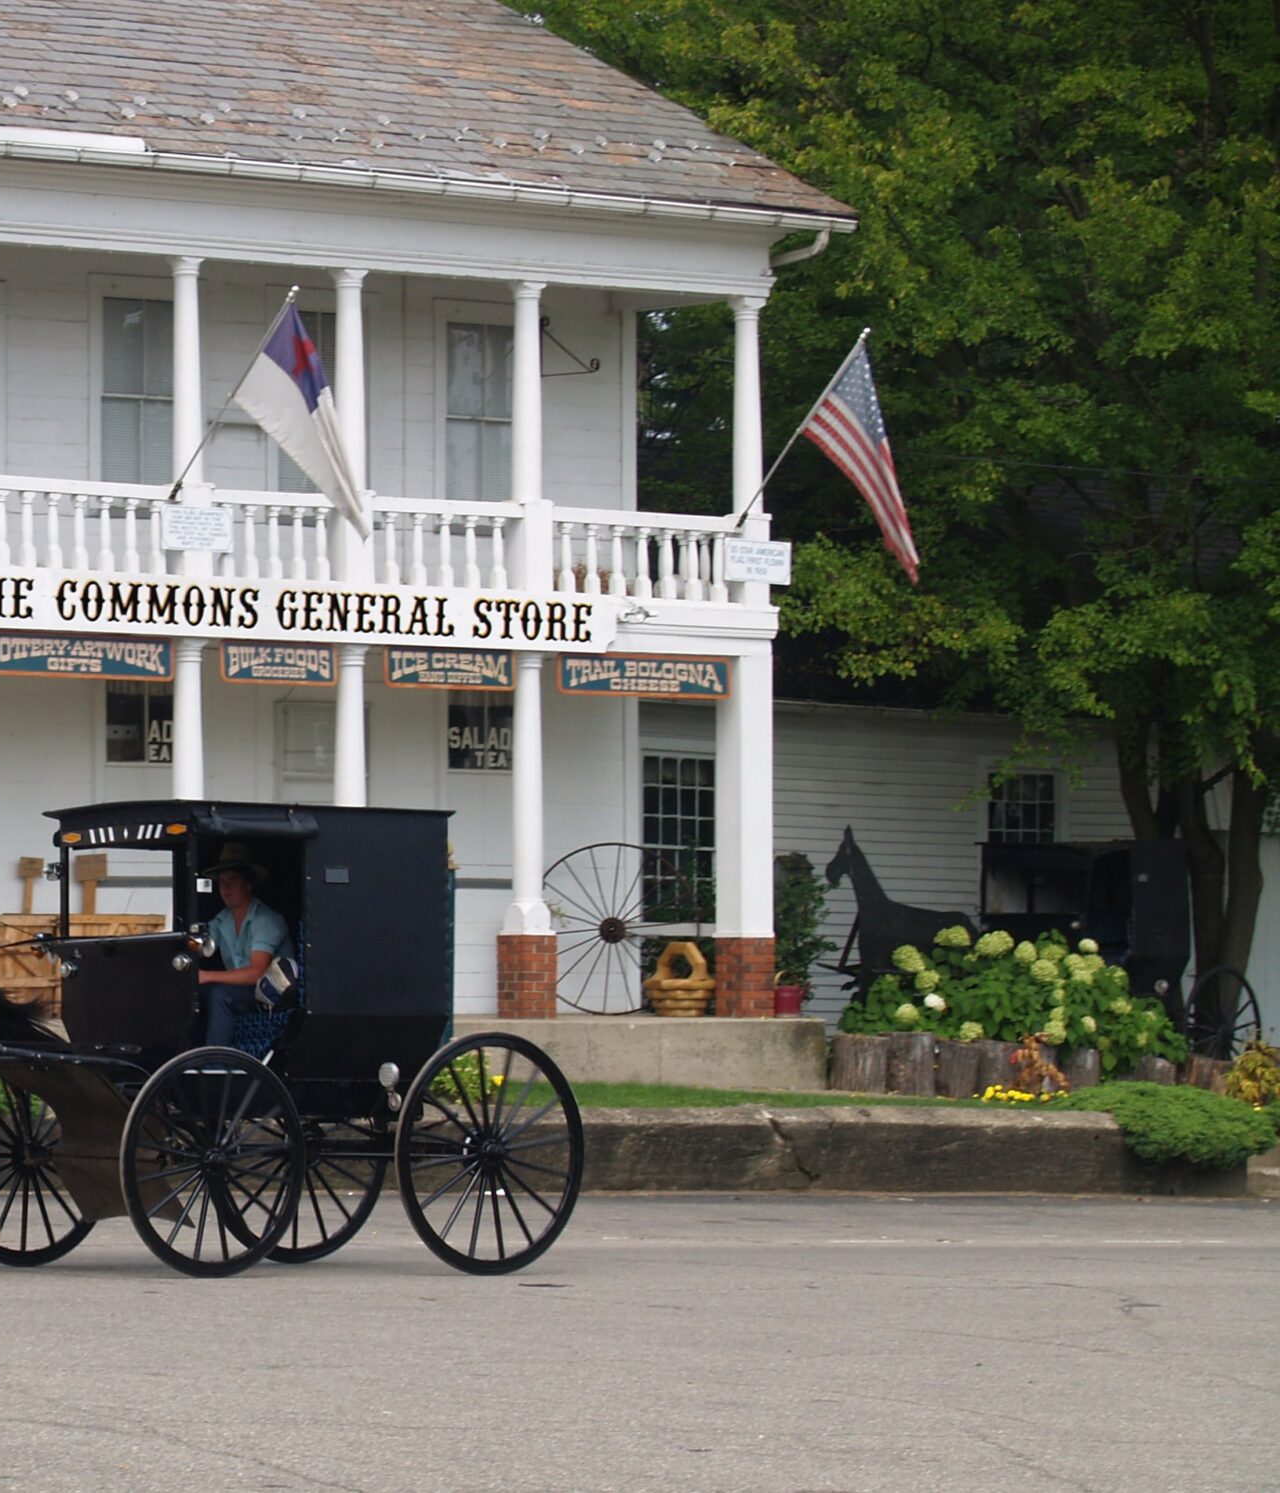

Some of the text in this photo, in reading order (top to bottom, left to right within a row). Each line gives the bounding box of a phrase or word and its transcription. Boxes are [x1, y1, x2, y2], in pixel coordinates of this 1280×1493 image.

[55, 579, 260, 629] COMMONS
[276, 590, 455, 637] GENERAL
[473, 597, 593, 643] STORE
[47, 657, 103, 673] GIFTS
[227, 645, 331, 679] BULK FOODS
[391, 651, 509, 685] ICE CREAM
[566, 658, 724, 693] TRAIL BOLOGNA
[609, 677, 681, 692] CHEESE
[474, 750, 509, 768] TEA
